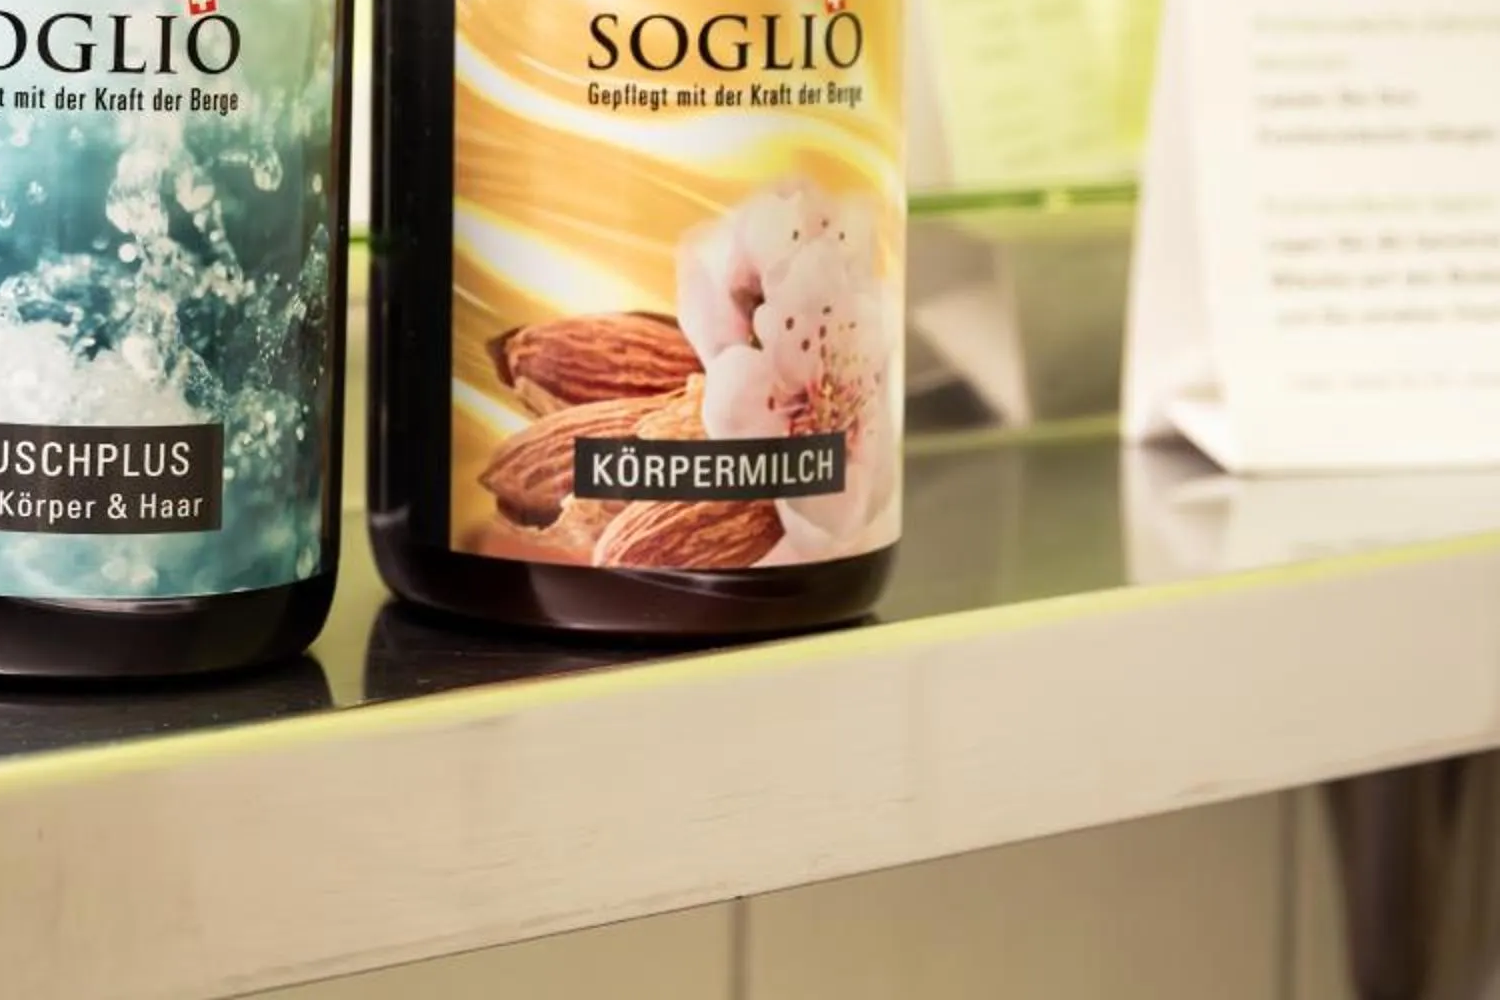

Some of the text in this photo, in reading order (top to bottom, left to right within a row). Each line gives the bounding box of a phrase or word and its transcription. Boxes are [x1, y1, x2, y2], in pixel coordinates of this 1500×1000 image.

[587, 11, 863, 71] SOGLIO
[14, 85, 45, 109] mit
[54, 86, 86, 110] der
[95, 87, 143, 111] Kraft
[153, 87, 182, 111] der
[190, 87, 238, 115] Berge
[587, 81, 863, 111] Gepflegt mit der Kraft der Berge
[592, 447, 834, 488] KÖRPERMILCH
[107, 493, 128, 519] &
[139, 493, 203, 519] Haar
